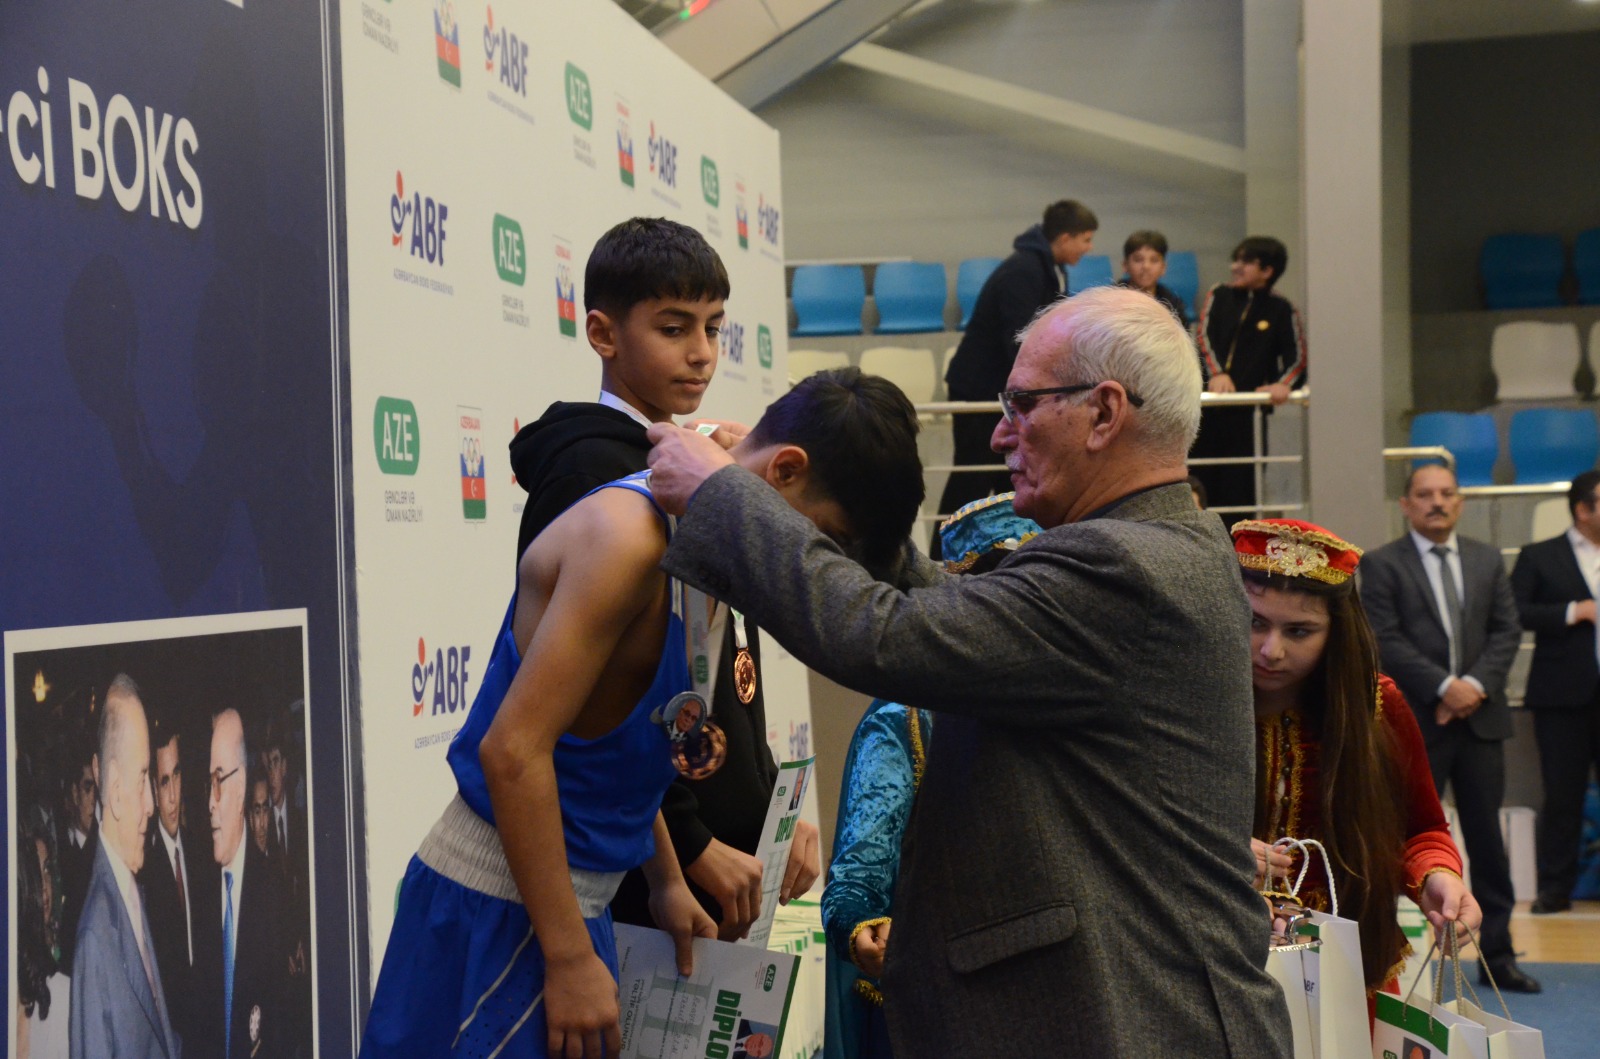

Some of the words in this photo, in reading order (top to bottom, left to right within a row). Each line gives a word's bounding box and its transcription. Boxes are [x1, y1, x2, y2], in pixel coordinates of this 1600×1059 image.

[500, 26, 528, 98] ABF
[569, 73, 590, 121] AZE
[68, 77, 204, 230] BOKS
[659, 135, 677, 189] ABF
[410, 191, 448, 267] ABF
[498, 226, 523, 275] AZE
[382, 411, 413, 462] AZE
[432, 645, 470, 716] ABF
[703, 989, 742, 1059] DİPLO
